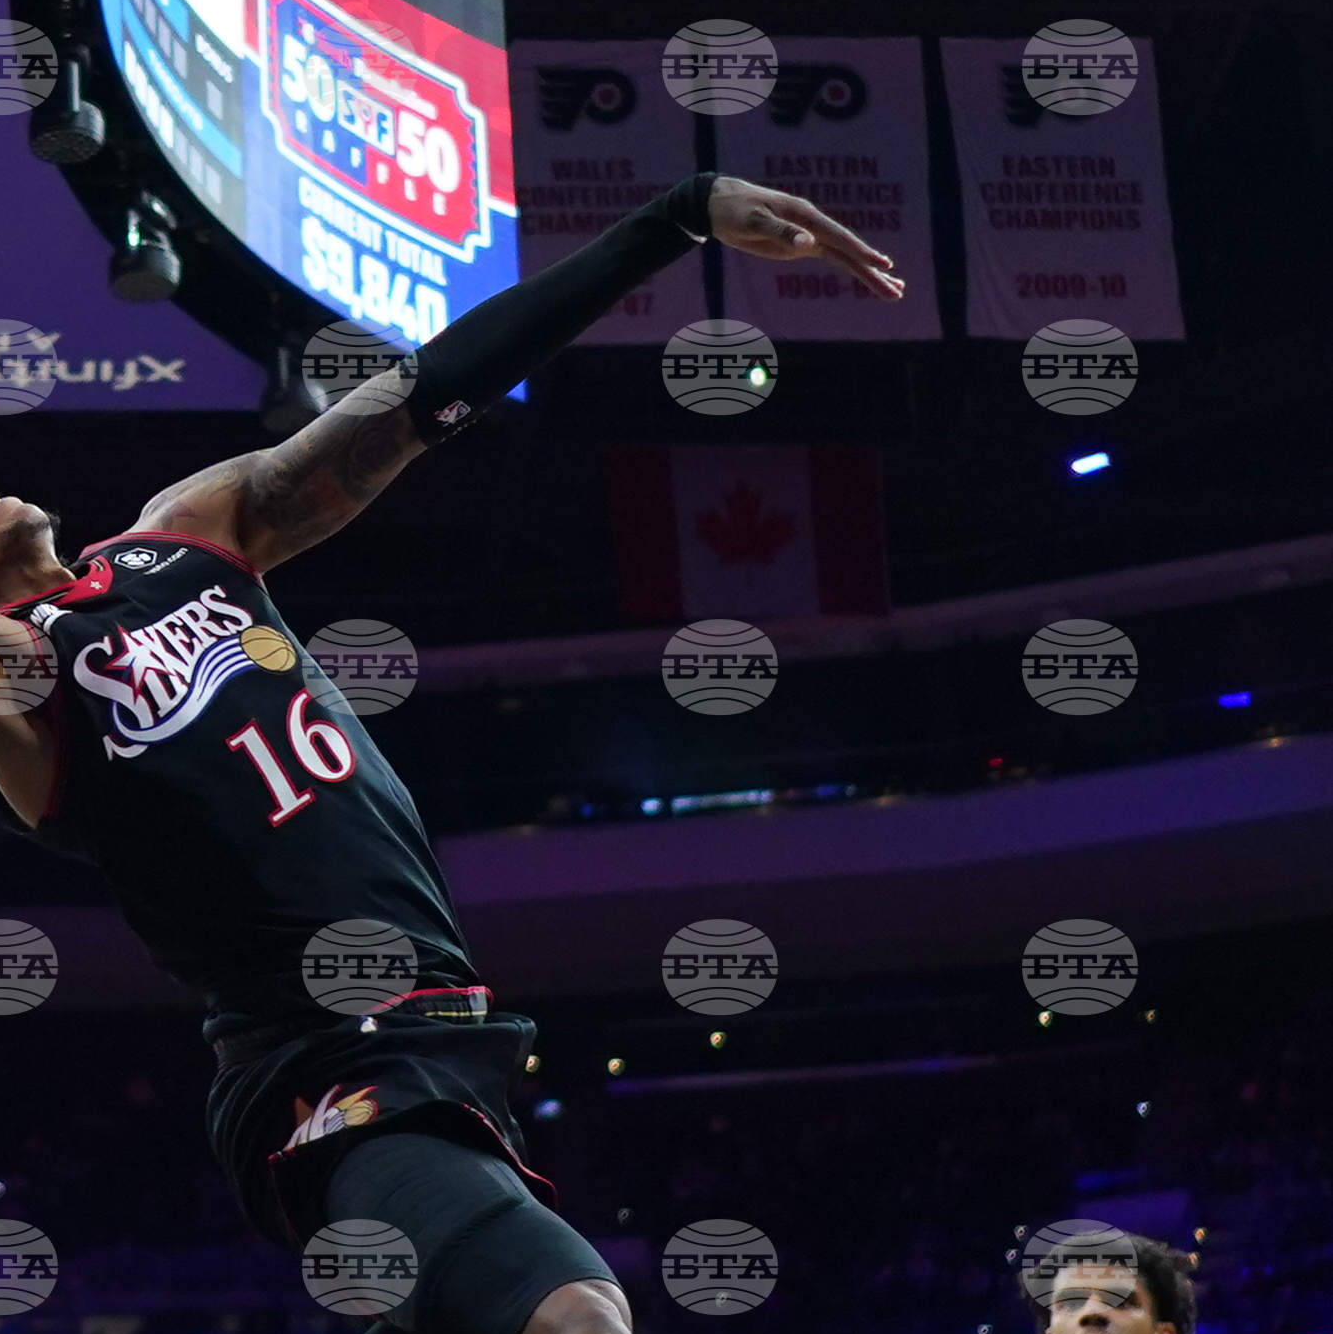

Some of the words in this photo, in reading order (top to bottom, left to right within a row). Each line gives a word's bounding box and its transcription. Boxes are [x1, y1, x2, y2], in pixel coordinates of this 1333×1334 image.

[282, 34, 337, 122] 50
[396, 110, 462, 193] 50
[765, 155, 879, 179] EASTERN
[980, 181, 1144, 205] CONFERENCE
[1002, 155, 1116, 178] EASTERN
[298, 176, 384, 252] CURRENT
[385, 230, 448, 287] TOTAL
[989, 208, 1142, 231] CHAMPIONS
[301, 215, 449, 347] $9,840
[225, 688, 356, 828] 16
